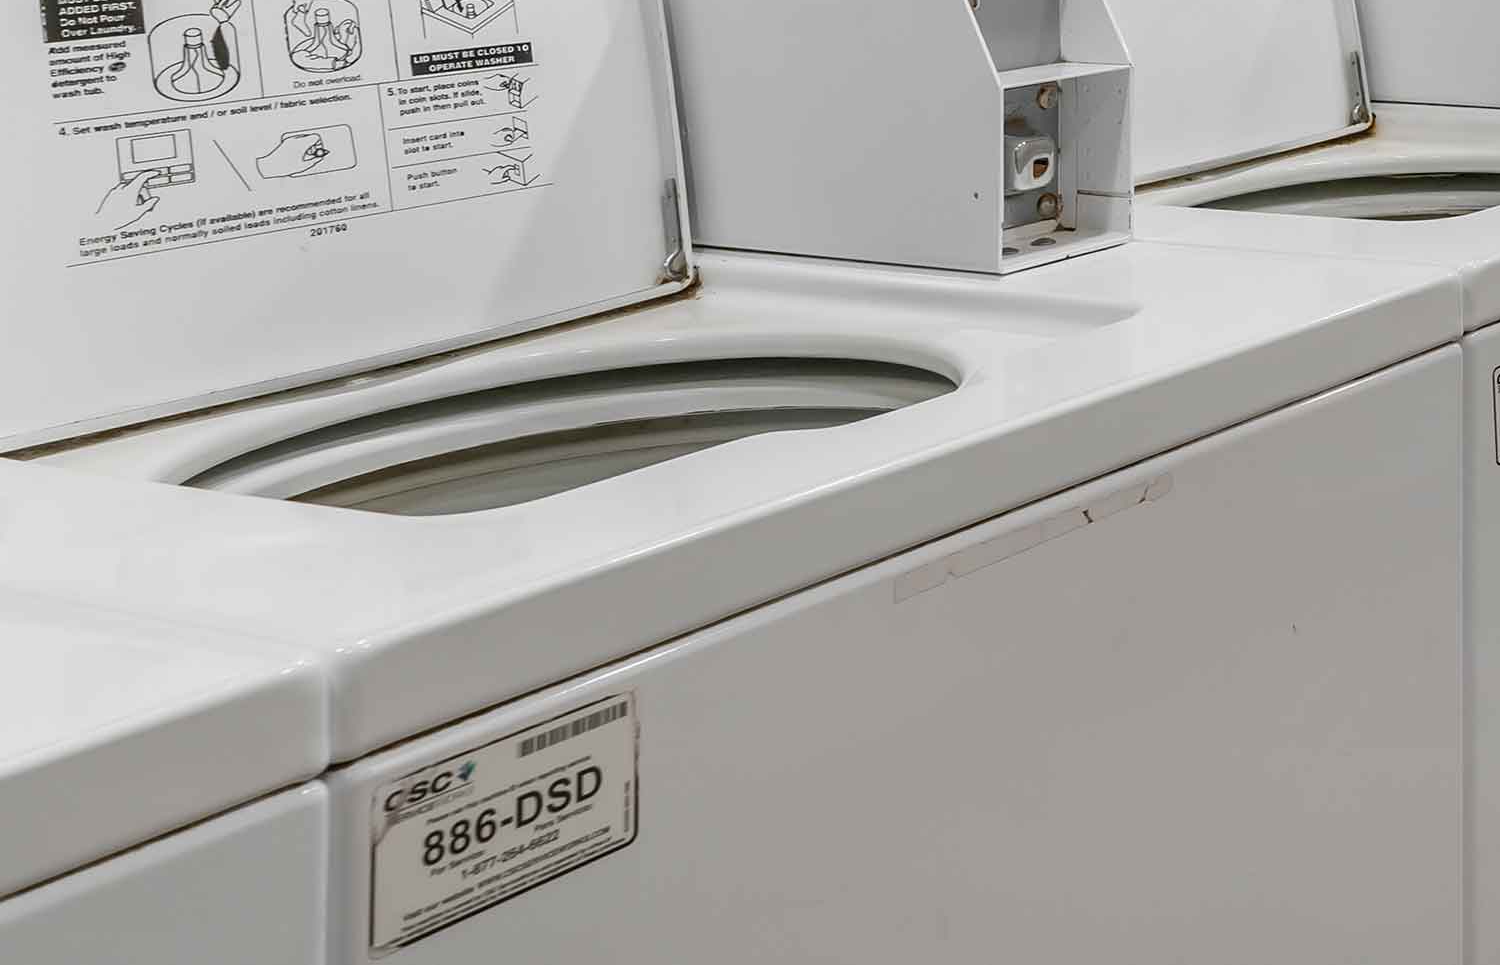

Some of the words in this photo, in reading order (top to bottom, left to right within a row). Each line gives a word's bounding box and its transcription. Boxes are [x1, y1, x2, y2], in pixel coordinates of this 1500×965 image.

[58, 4, 100, 15] ADDED
[101, 1, 136, 11] FIRST.
[412, 55, 430, 63] LID
[431, 51, 459, 61] MUST
[461, 50, 475, 58] BE
[476, 46, 514, 56] CLOSED
[516, 44, 532, 52] TO
[428, 60, 473, 71] OPERATE
[474, 56, 515, 66] WASHER
[384, 772, 453, 812] CSC
[422, 766, 604, 866] 886-DSD
